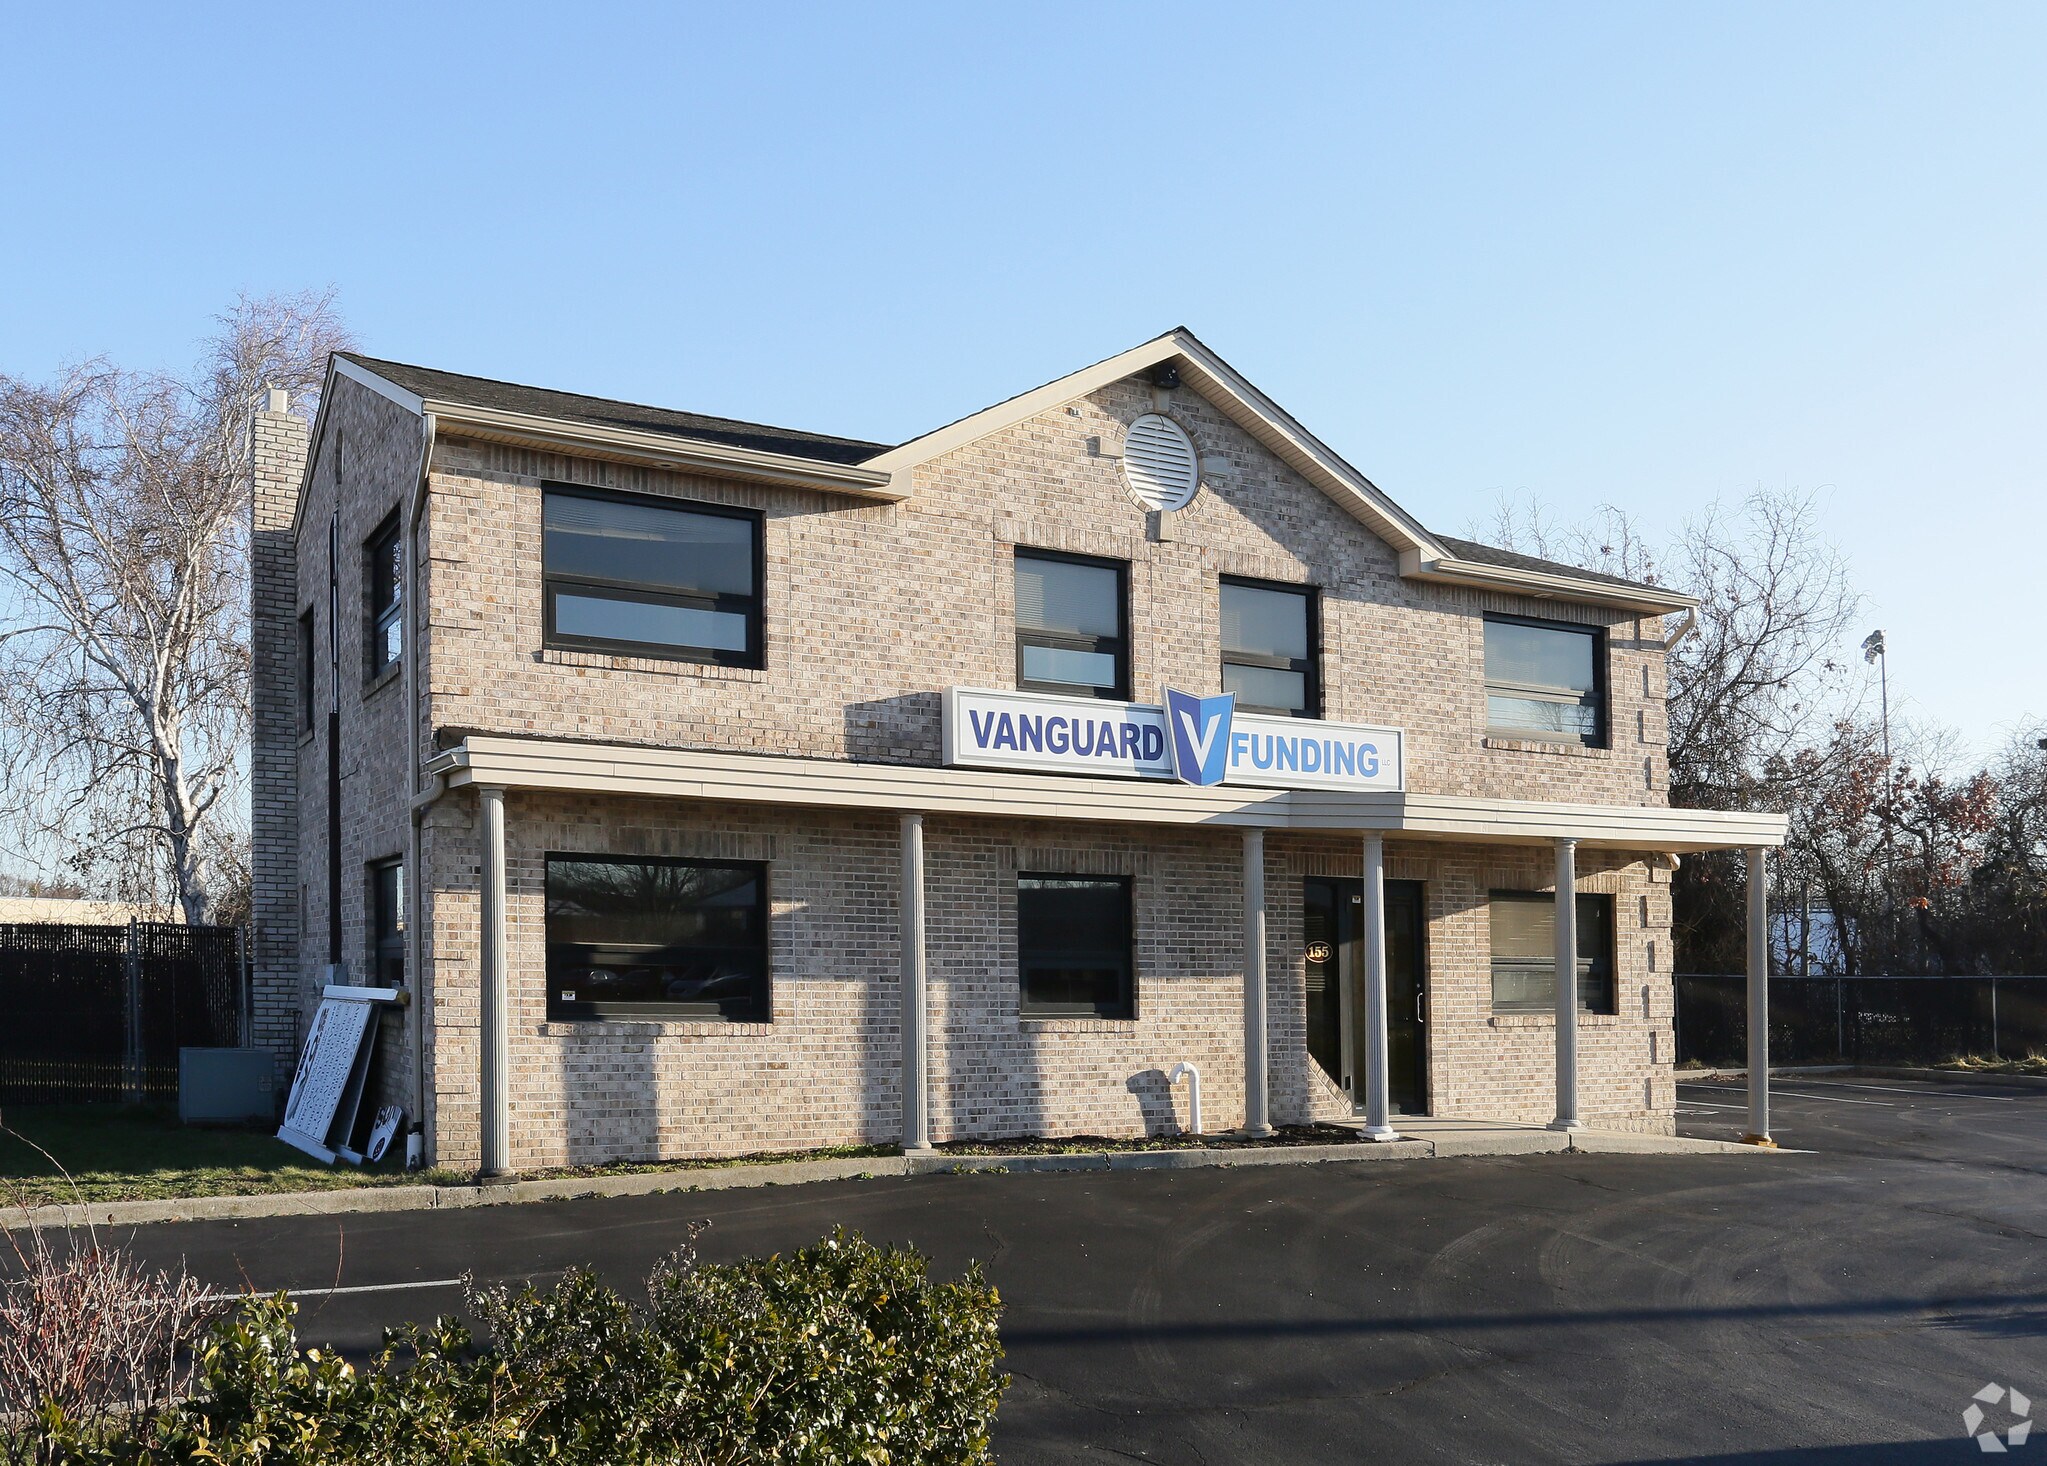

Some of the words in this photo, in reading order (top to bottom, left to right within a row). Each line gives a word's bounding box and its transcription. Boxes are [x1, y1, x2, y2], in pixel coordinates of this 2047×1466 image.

[968, 709, 1164, 761] VANGUARD
[1178, 709, 1222, 774] V
[1231, 733, 1379, 778] FUNDING
[1308, 946, 1329, 958] 155
